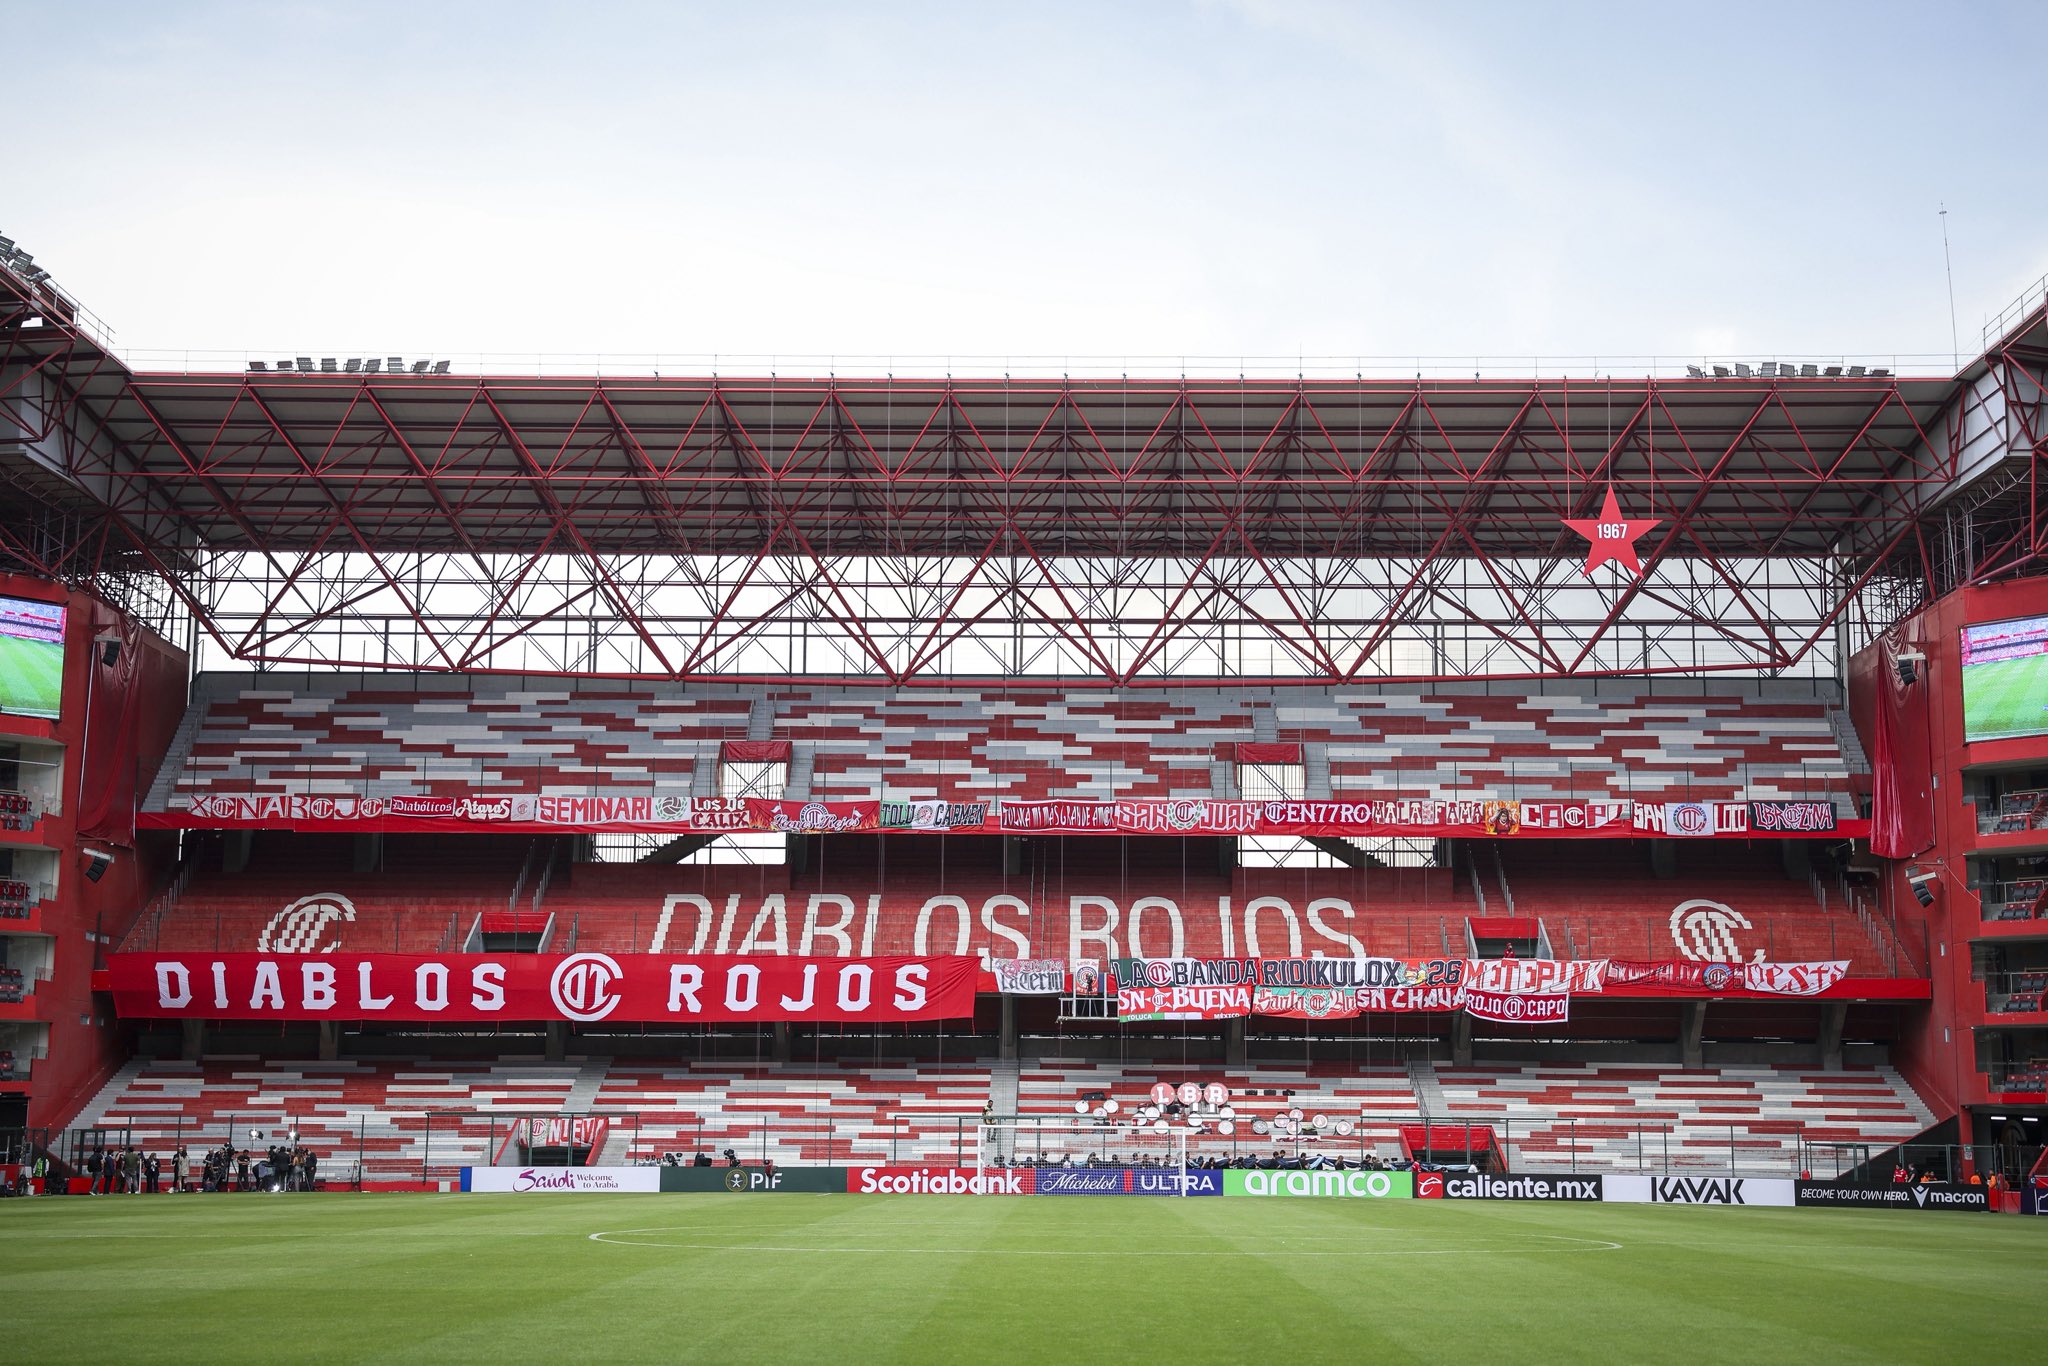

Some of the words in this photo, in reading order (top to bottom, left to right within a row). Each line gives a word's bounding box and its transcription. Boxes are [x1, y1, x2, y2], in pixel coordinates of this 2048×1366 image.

[1597, 523, 1628, 539] 1967
[1113, 960, 1149, 988] LA
[1172, 960, 1258, 986] BANDA
[1262, 959, 1402, 988] RIDIKULOX
[1427, 960, 1463, 987] 26
[154, 961, 507, 1011] DIABLOS
[666, 963, 930, 1013] ROJOS
[1171, 987, 1251, 1012] BUENA
[1467, 994, 1500, 1014] ROJO
[1527, 998, 1566, 1017] CAPO
[512, 1168, 576, 1192] Saudi
[594, 1181, 619, 1189] Arabia
[751, 1172, 782, 1189] PIF
[860, 1168, 1022, 1194] Scotiabank
[1042, 1172, 1117, 1191] Michelob
[1141, 1174, 1215, 1191] ULTRA
[1243, 1170, 1392, 1197] aramco
[1446, 1173, 1598, 1200] caliente.mx
[1650, 1177, 1745, 1205] KAVAK
[1800, 1188, 1835, 1199] BECOME
[1836, 1188, 1860, 1200] YOUR
[1860, 1189, 1883, 1201] OWN
[1883, 1190, 1910, 1202] HERO.
[1930, 1192, 1986, 1204] macron
